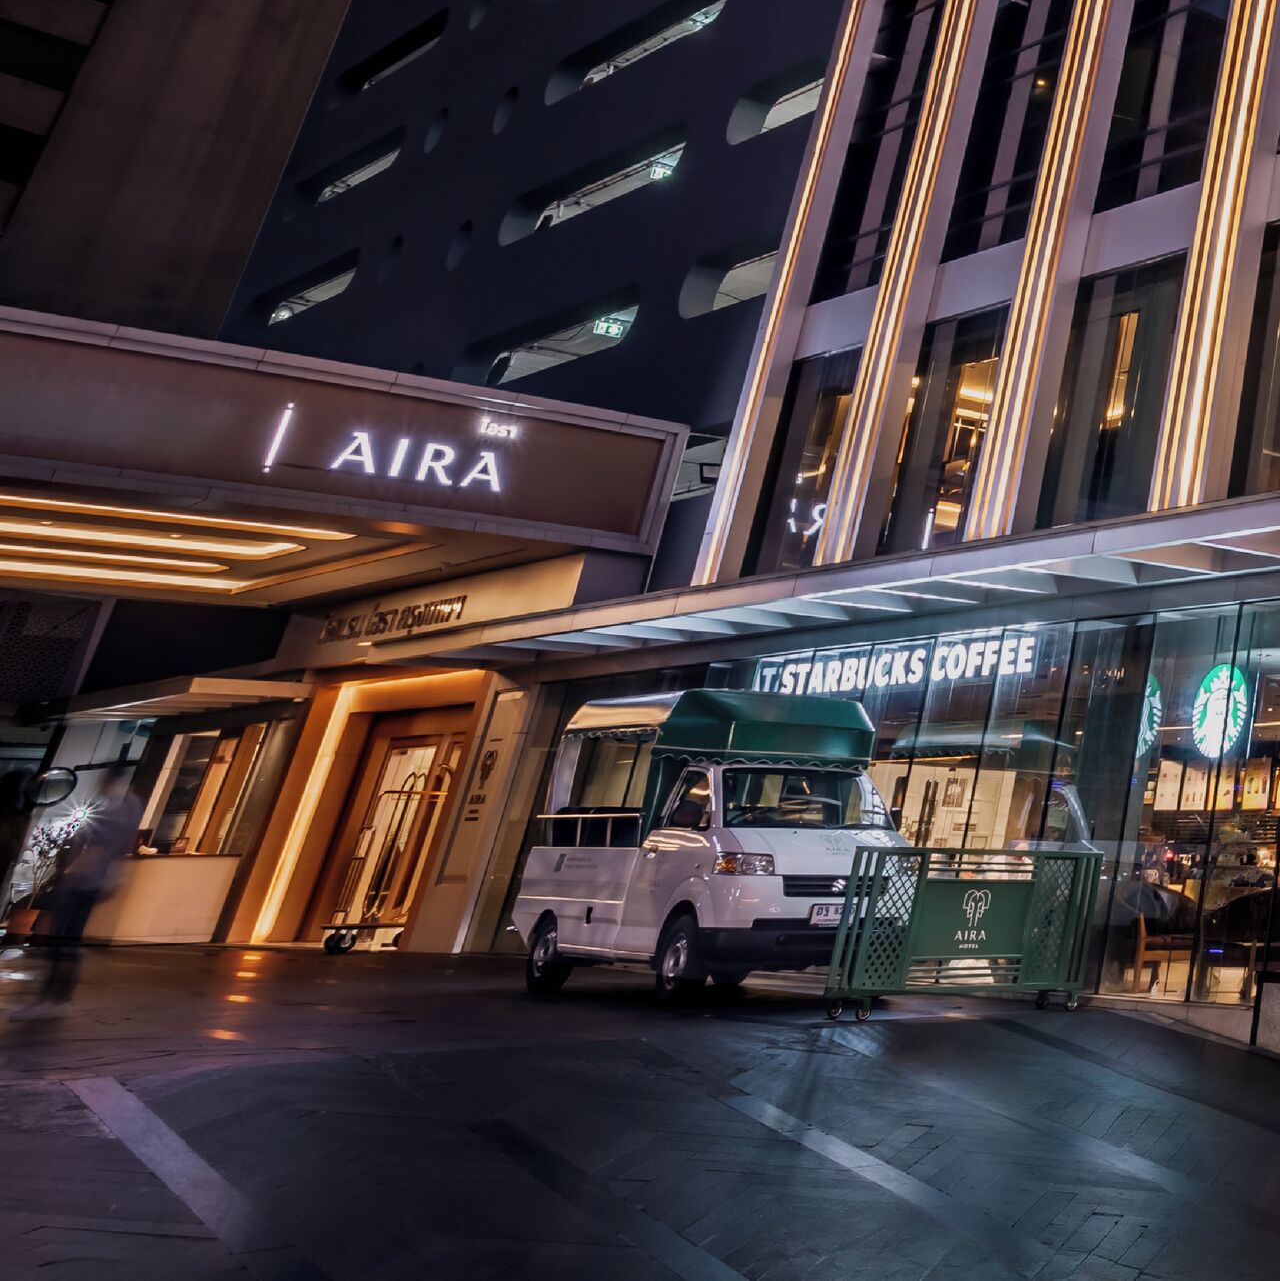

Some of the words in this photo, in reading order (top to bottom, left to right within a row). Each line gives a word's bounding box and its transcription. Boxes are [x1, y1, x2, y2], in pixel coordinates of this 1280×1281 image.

[479, 418, 518, 439] ไอรา
[329, 431, 502, 493] AIRA
[779, 648, 926, 695] STARBUCKS
[930, 637, 1036, 682] COFFEE
[954, 929, 987, 942] AIRA
